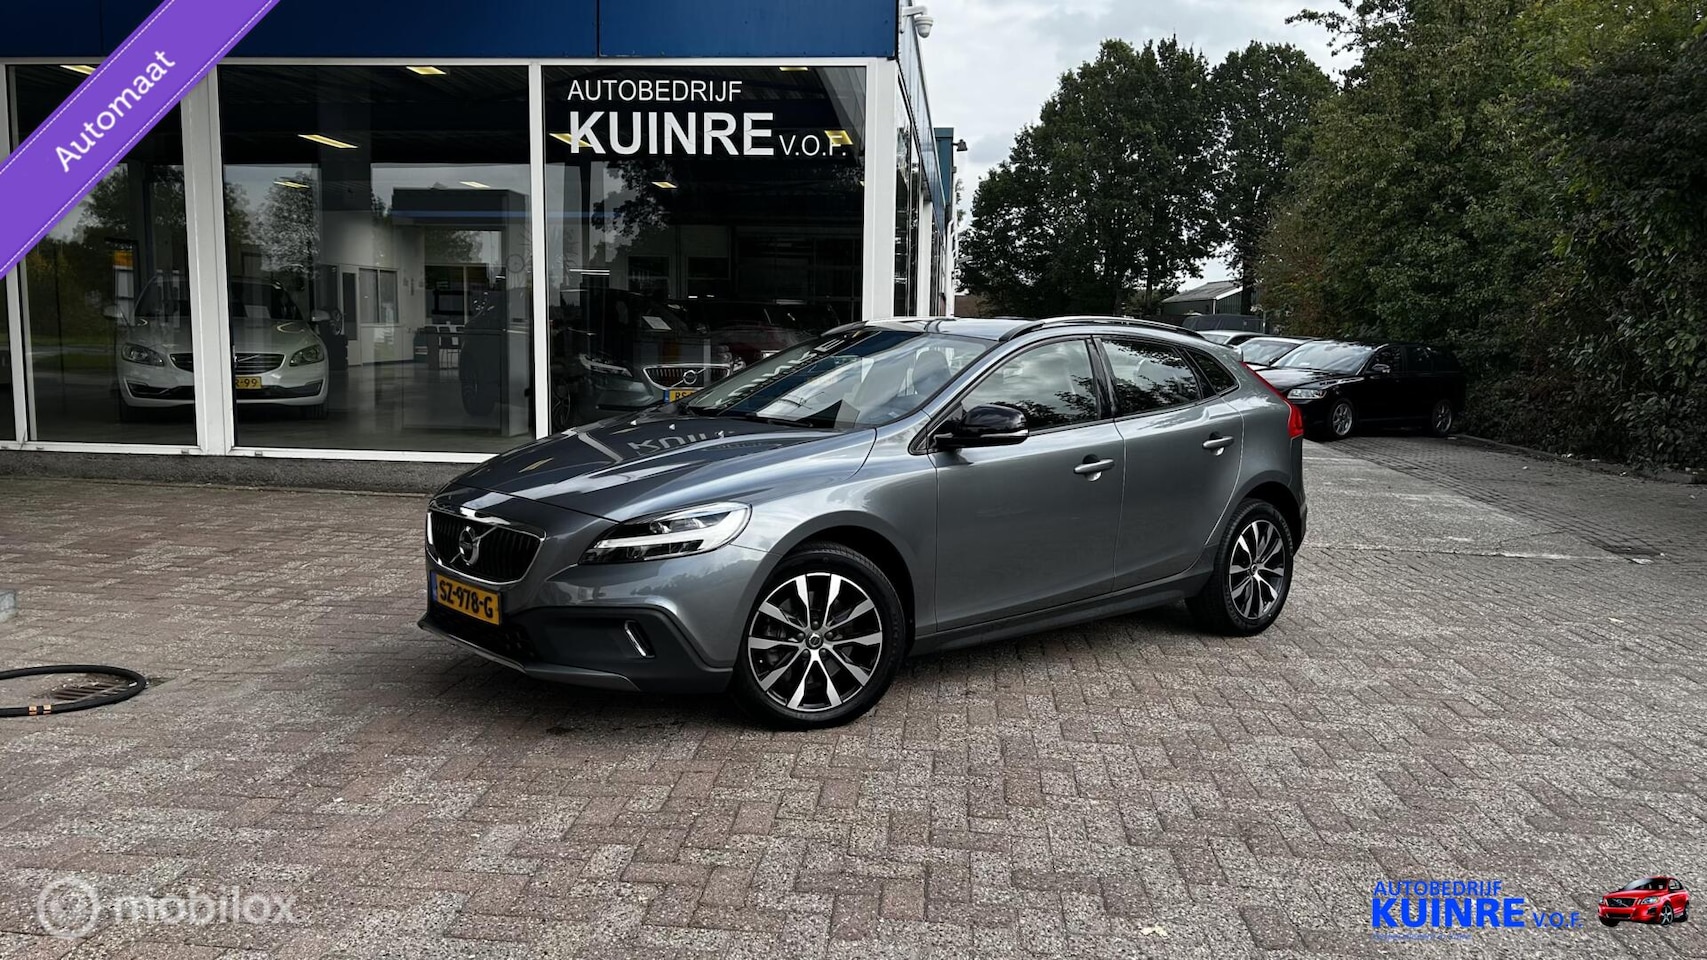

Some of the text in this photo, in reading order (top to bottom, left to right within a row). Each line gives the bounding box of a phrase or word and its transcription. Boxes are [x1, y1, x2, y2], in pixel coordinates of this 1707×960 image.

[567, 79, 743, 102] AUTOBEDRIJF
[570, 111, 847, 156] KUINRE V.O.F.
[439, 580, 494, 618] SZ-978-G
